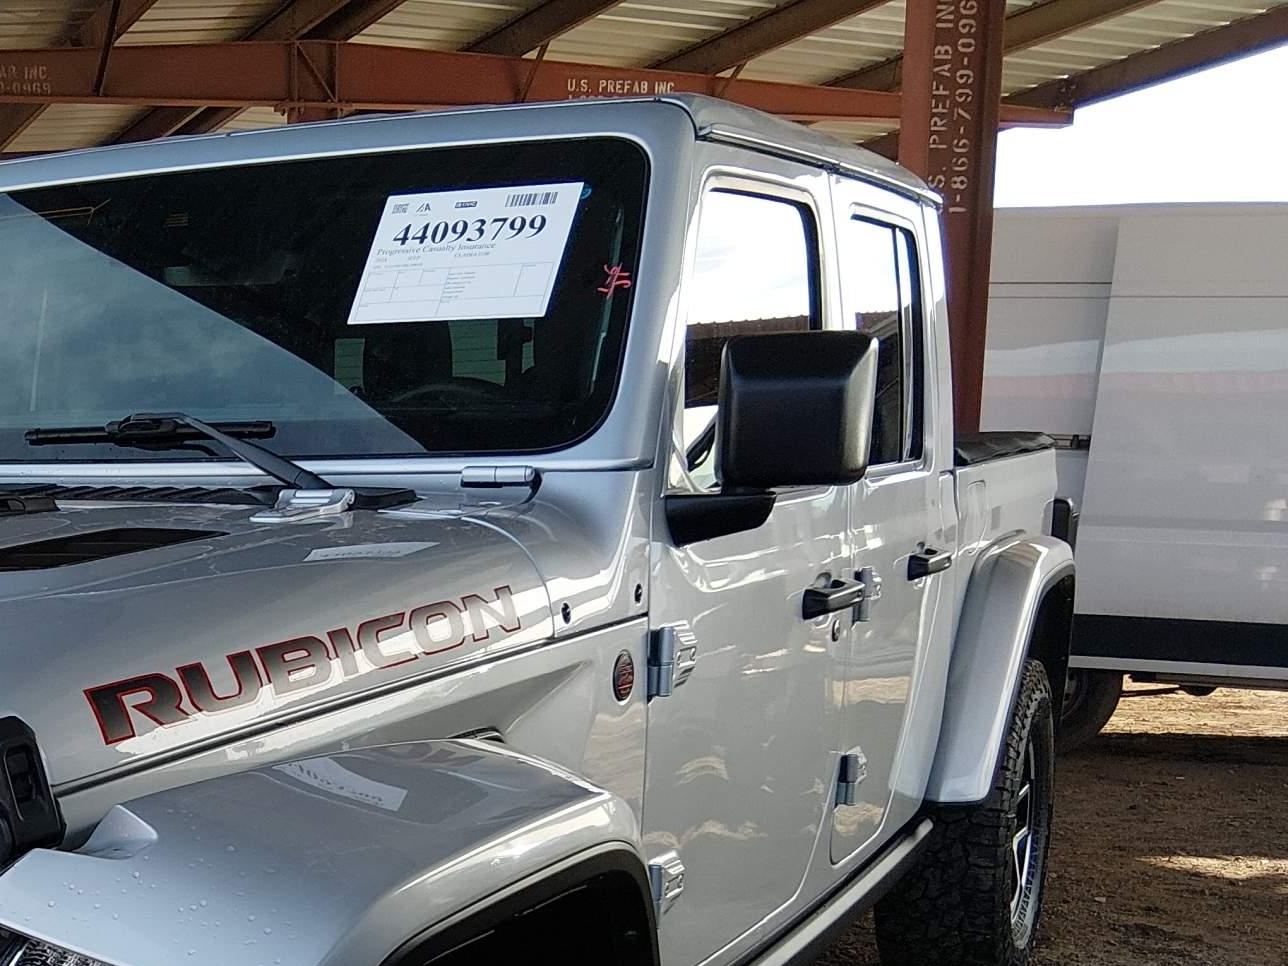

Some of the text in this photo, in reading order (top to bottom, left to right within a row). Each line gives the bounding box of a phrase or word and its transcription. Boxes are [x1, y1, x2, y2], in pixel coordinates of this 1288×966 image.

[935, 0, 955, 28] IN
[567, 79, 592, 93] U.S.
[598, 80, 648, 94] PREFAB
[928, 45, 954, 149] PREFAB
[393, 214, 547, 246] 44093799
[376, 242, 496, 257] Progressive Casualty Insurance
[83, 585, 521, 745] RUBICON
